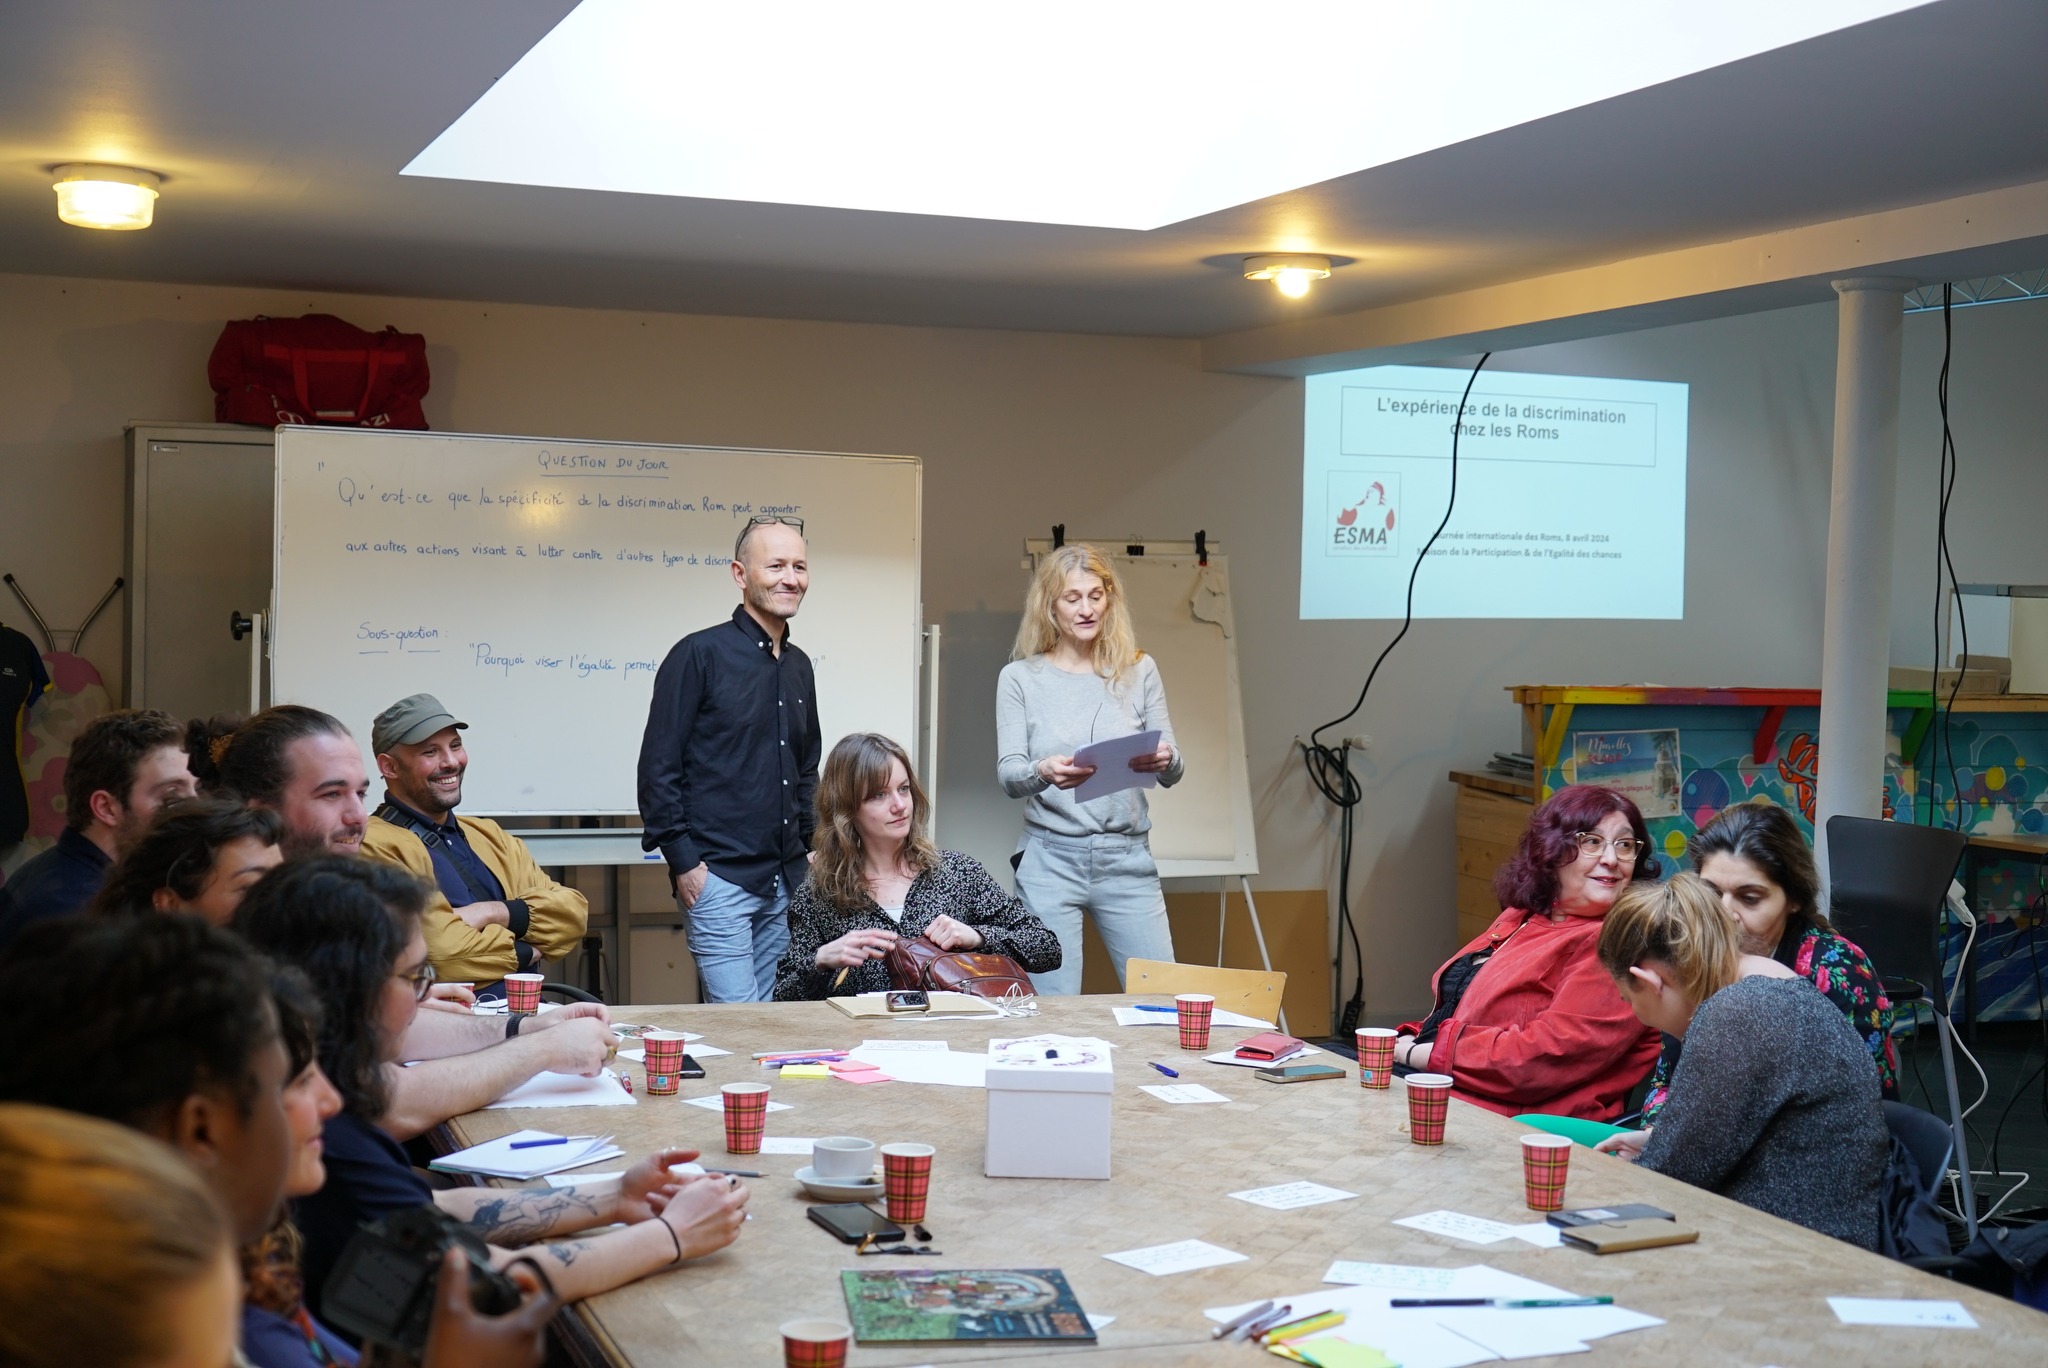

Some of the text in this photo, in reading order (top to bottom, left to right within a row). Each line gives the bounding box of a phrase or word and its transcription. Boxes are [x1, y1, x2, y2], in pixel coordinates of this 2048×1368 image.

[1377, 397, 1627, 424] L'expérience de la discrimination
[1490, 422, 1512, 438] les
[1517, 424, 1560, 440] Roms
[538, 450, 669, 470] QUESTION DU JOUR
[448, 493, 472, 511] que
[479, 487, 494, 506] la
[498, 489, 564, 508] spécificité
[578, 493, 592, 506] de
[598, 493, 610, 508] la
[617, 495, 696, 511] discrimination
[702, 496, 726, 512] Rom
[732, 502, 752, 519] peut
[760, 504, 802, 517] apporter
[1333, 526, 1388, 545] ESMA
[1432, 531, 1610, 543] ournée internationale des Roms, 8 avril 2024
[346, 542, 369, 552] aux
[374, 539, 407, 554] autres
[417, 544, 460, 557] actions
[472, 545, 507, 557] visant
[538, 543, 565, 558] lutter
[573, 549, 602, 560] contre
[616, 548, 653, 562] d'autres
[662, 549, 684, 568] types
[687, 553, 699, 566] de
[1450, 547, 1460, 556] de
[1462, 547, 1469, 556] la
[1471, 547, 1522, 558] Participation
[1524, 548, 1531, 557] &
[1532, 548, 1543, 558] de
[1577, 550, 1590, 559] des
[1592, 550, 1622, 560] chances
[357, 621, 439, 650] Sous-question
[535, 655, 564, 668] viser
[569, 654, 616, 679] l'égalité
[624, 659, 657, 681] permet
